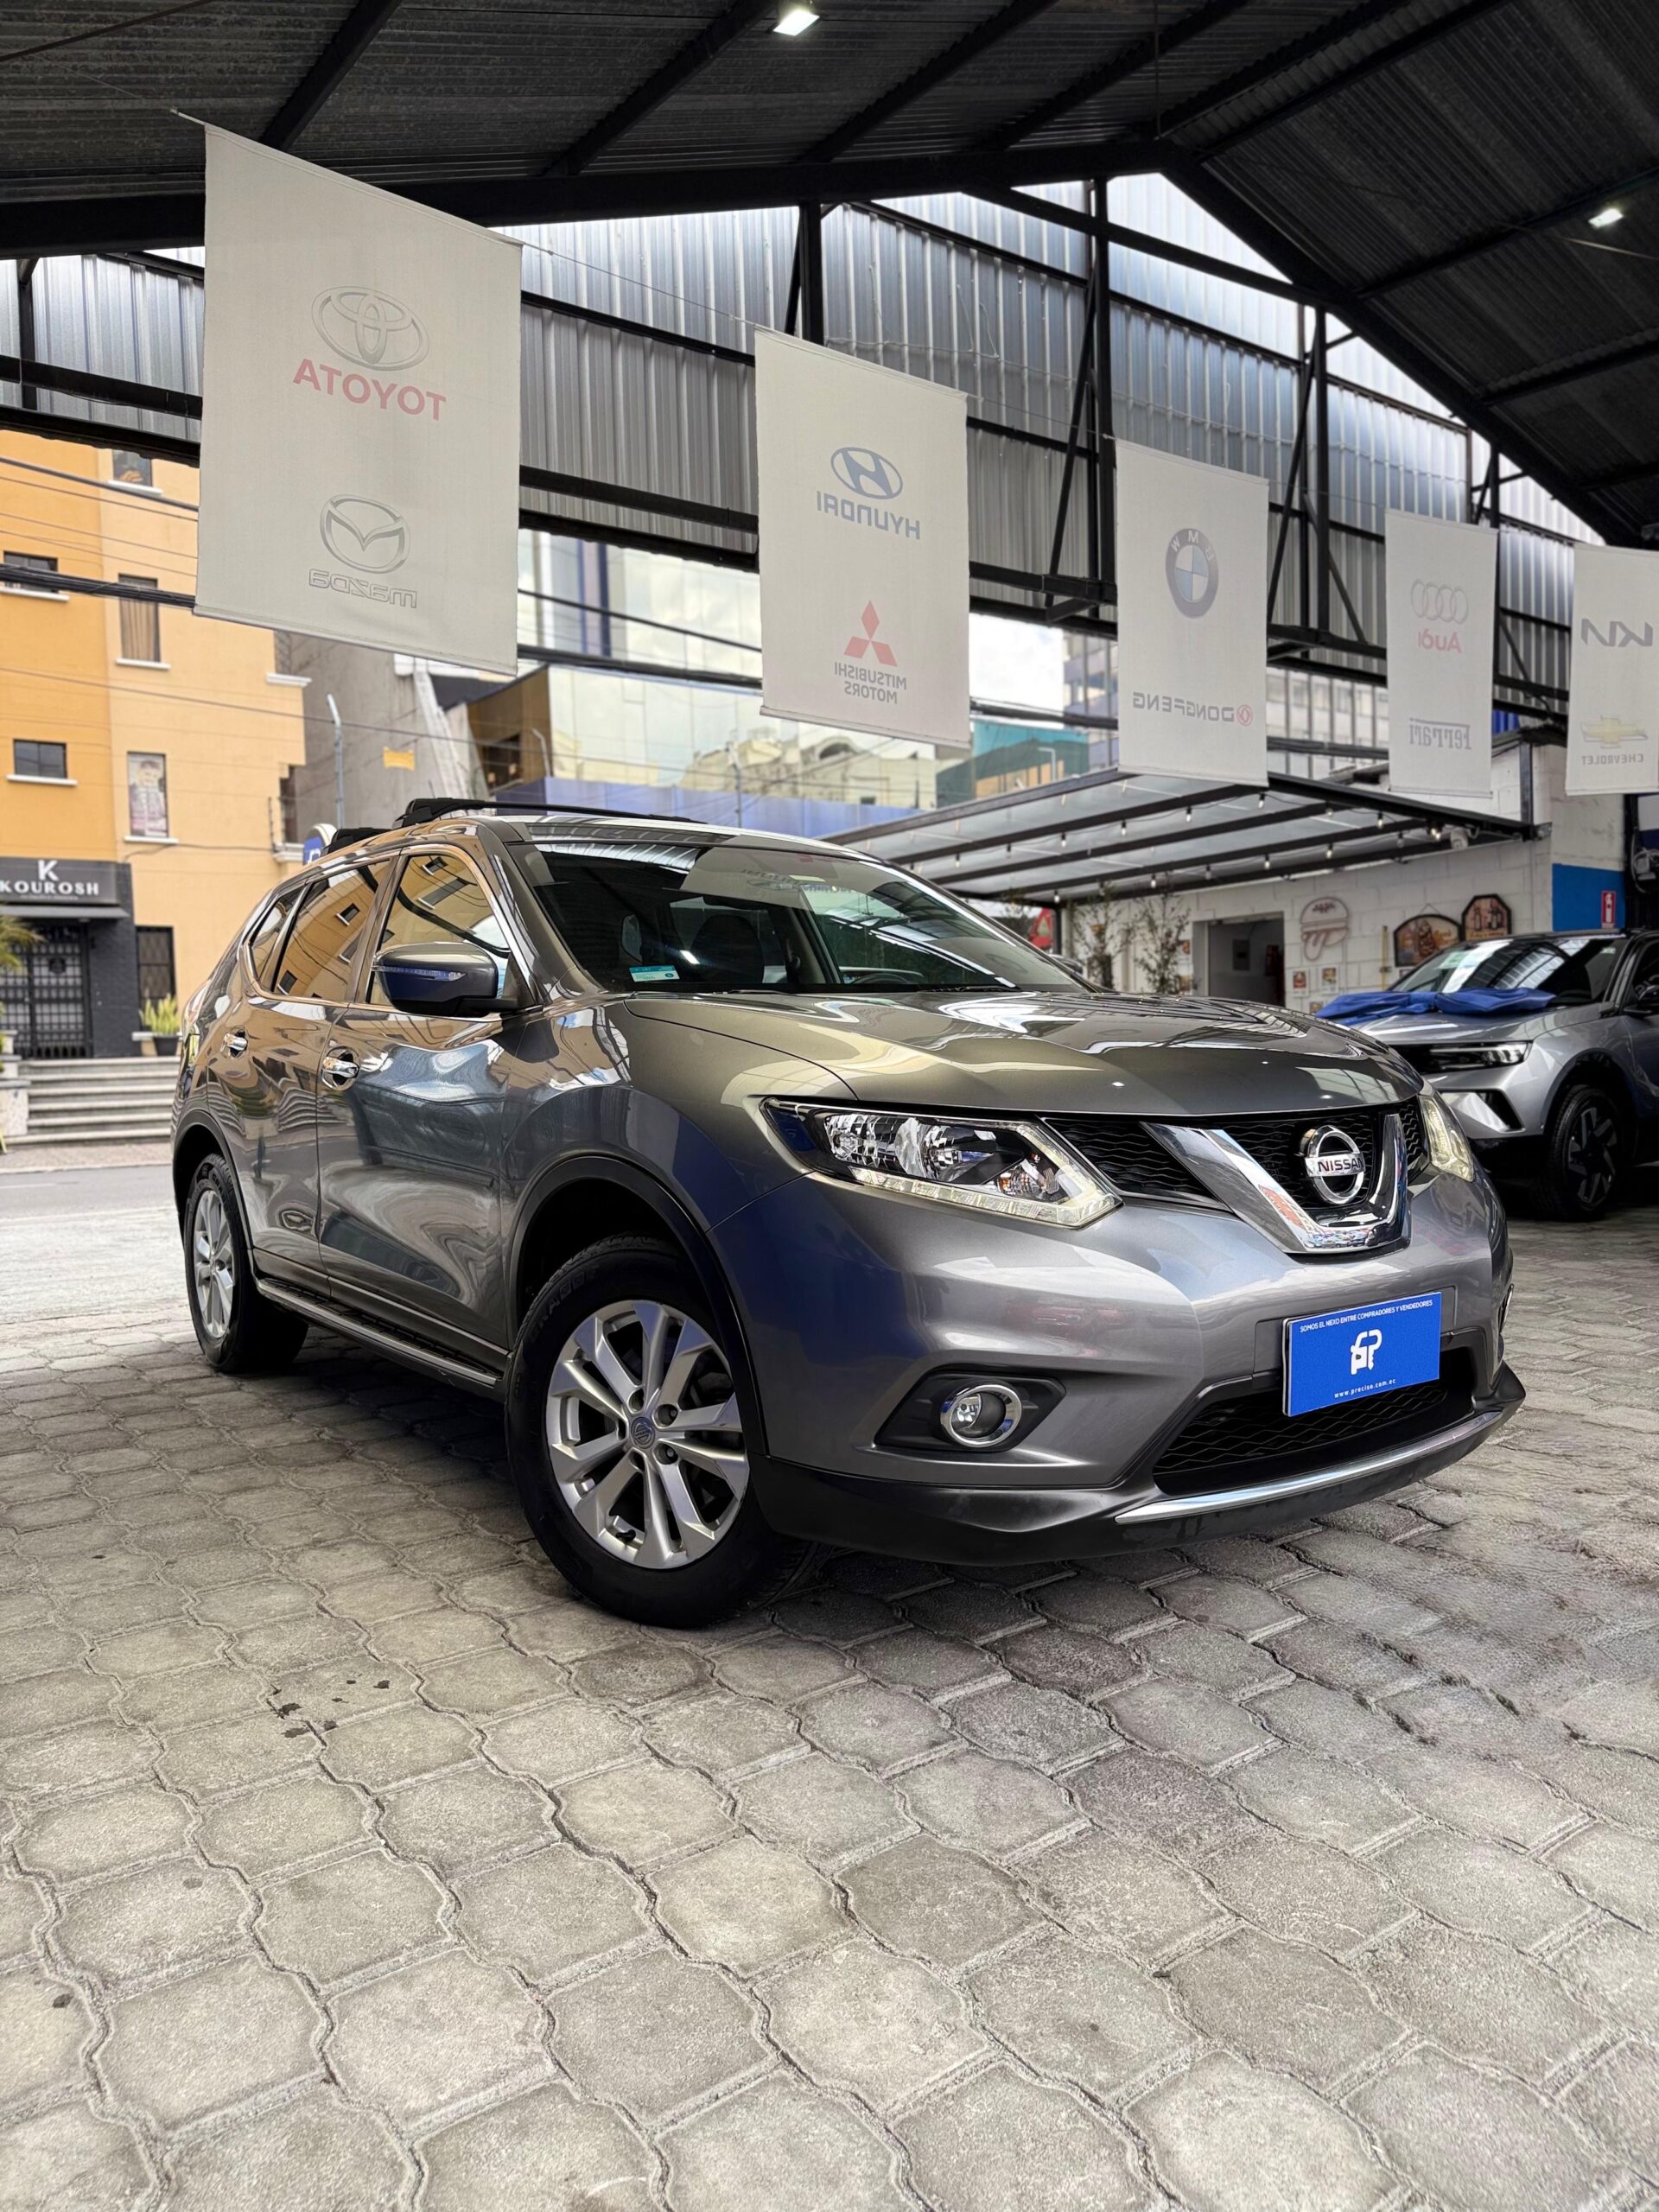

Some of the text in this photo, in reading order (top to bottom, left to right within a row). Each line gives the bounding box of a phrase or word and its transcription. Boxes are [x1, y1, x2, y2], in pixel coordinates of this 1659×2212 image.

[37, 859, 60, 881] K
[0, 879, 99, 896] KOUROSH
[1317, 1157, 1365, 1173] NISSAN
[1300, 1322, 1319, 1333] SOMOS
[1319, 1320, 1326, 1329] EL
[1325, 1318, 1340, 1327] NEXO
[1340, 1313, 1357, 1324] ENTRE
[1357, 1306, 1395, 1320] COMPRADORES
[1399, 1299, 1433, 1312] VENDEDORES
